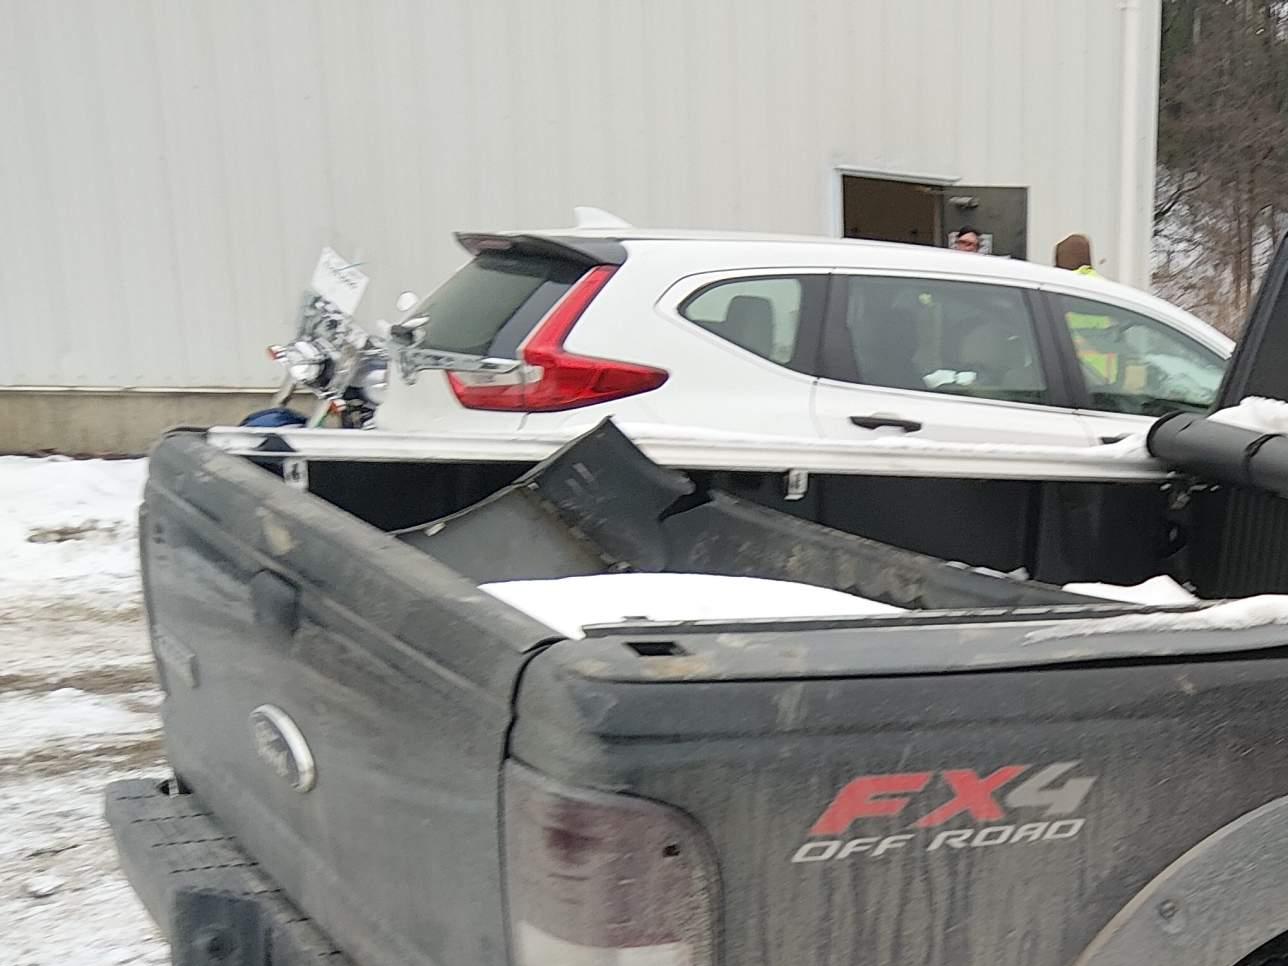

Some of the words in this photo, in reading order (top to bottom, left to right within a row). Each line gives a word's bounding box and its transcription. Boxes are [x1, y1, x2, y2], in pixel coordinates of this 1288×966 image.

[807, 759, 1097, 836] FX4
[791, 833, 915, 863] OFF
[927, 818, 1086, 852] ROAD
